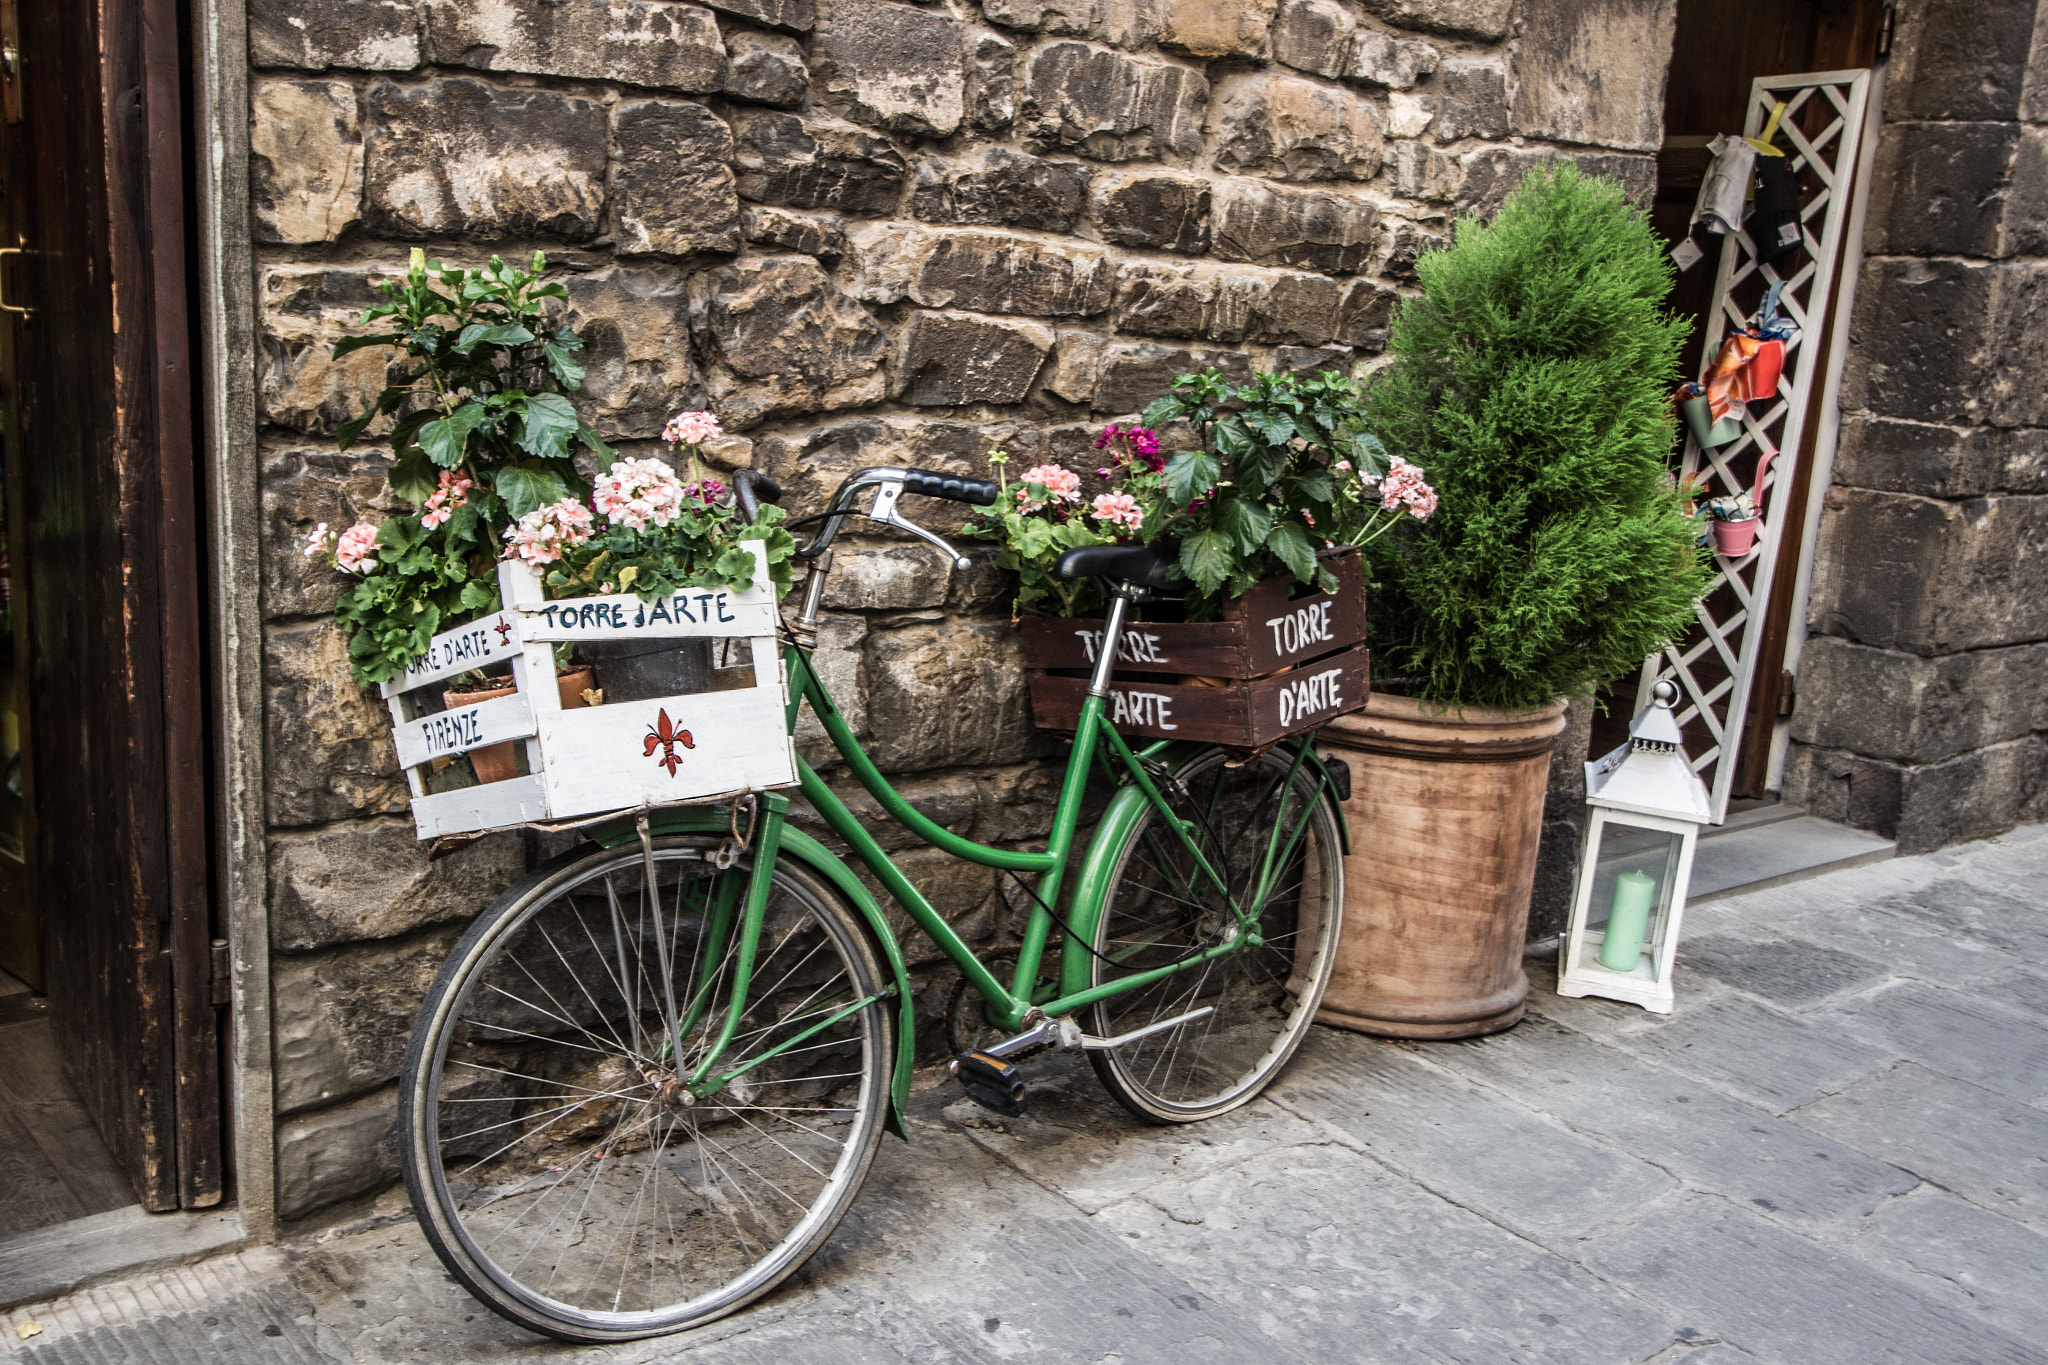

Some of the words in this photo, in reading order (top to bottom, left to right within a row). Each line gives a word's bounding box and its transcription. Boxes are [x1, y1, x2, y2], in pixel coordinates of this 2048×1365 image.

[538, 603, 628, 629] TORRE
[1266, 600, 1335, 657] TORRE
[443, 630, 490, 666] D'ARTE
[1108, 690, 1178, 730] ARTE
[1279, 668, 1343, 727] D'ARTE
[421, 709, 483, 754] FIRENZE
